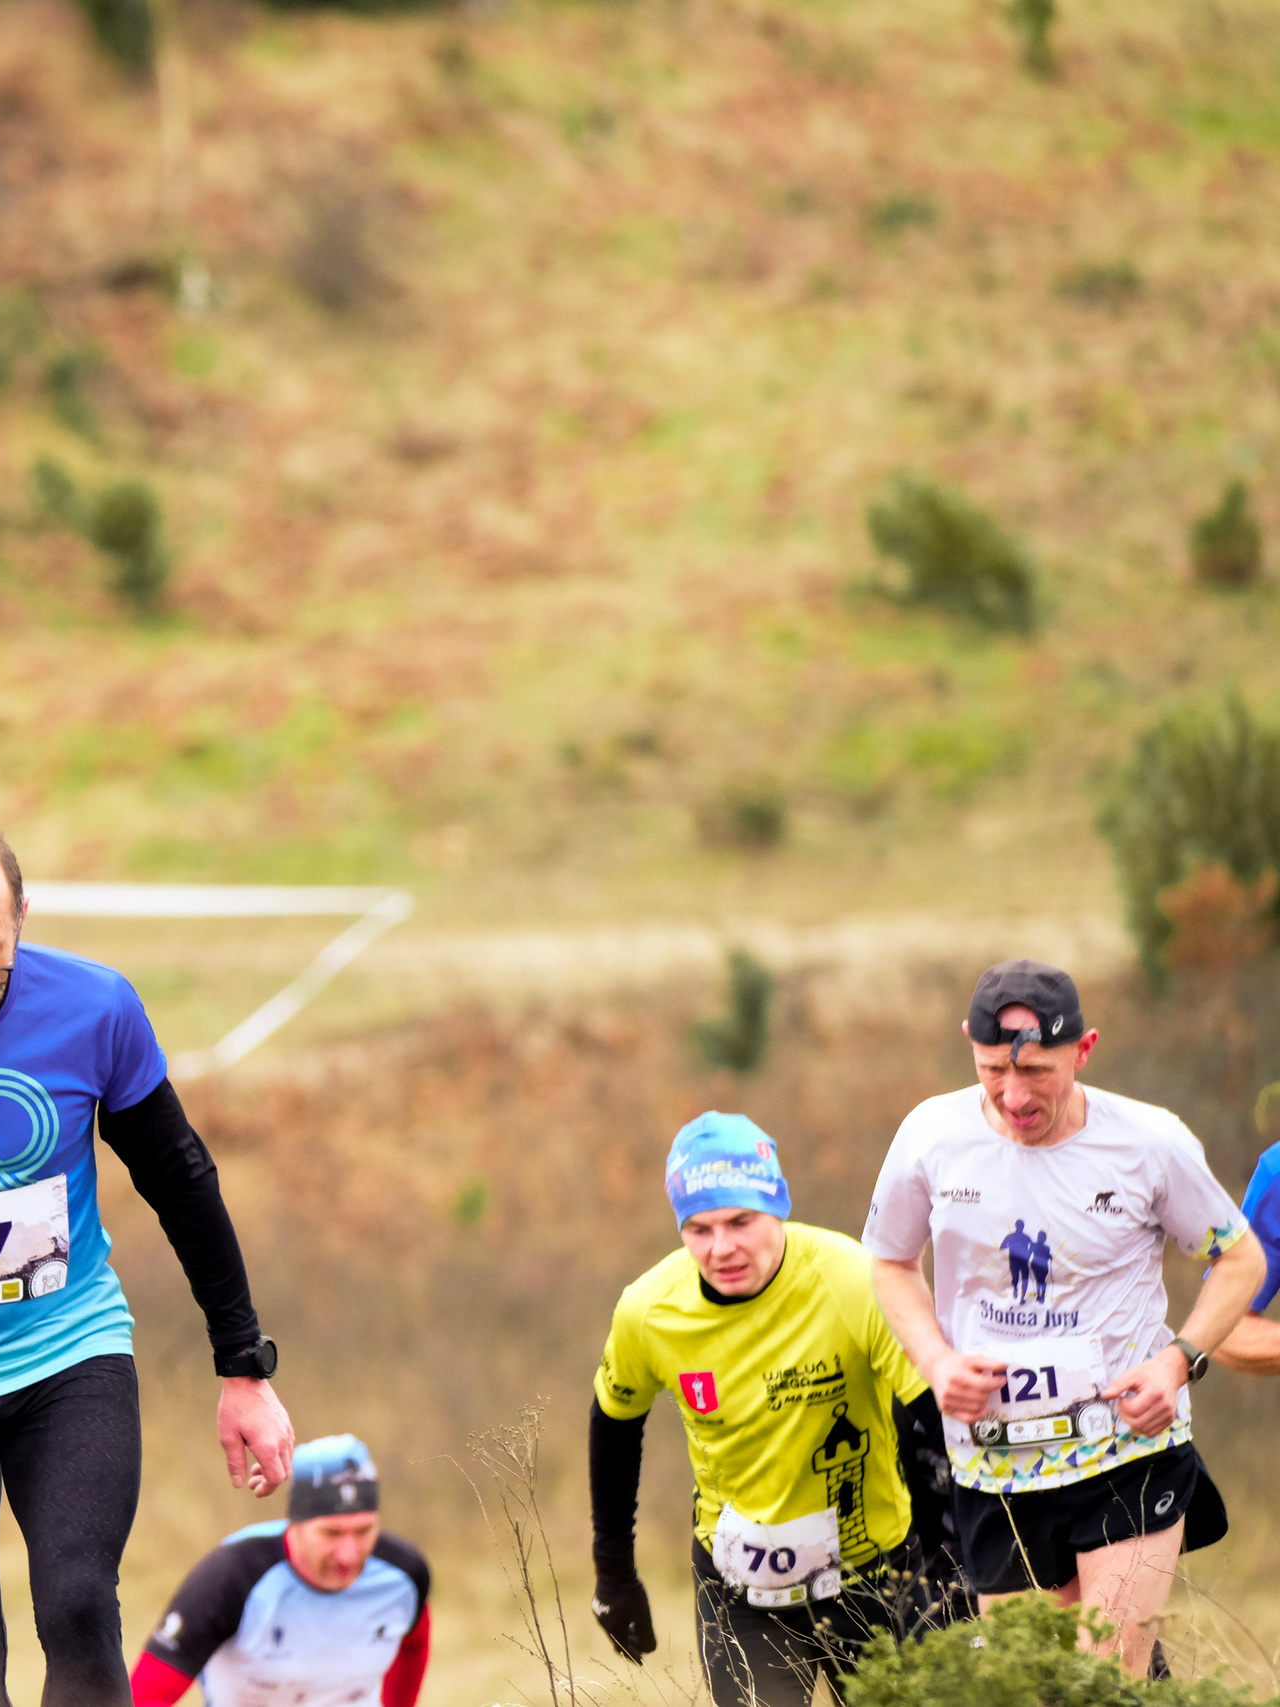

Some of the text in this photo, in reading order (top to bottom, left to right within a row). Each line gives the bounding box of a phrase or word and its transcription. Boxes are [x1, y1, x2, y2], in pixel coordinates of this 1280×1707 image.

[980, 1299, 1080, 1329] Słońca Jury
[991, 1365, 1059, 1404] 121
[743, 1542, 797, 1576] 70
